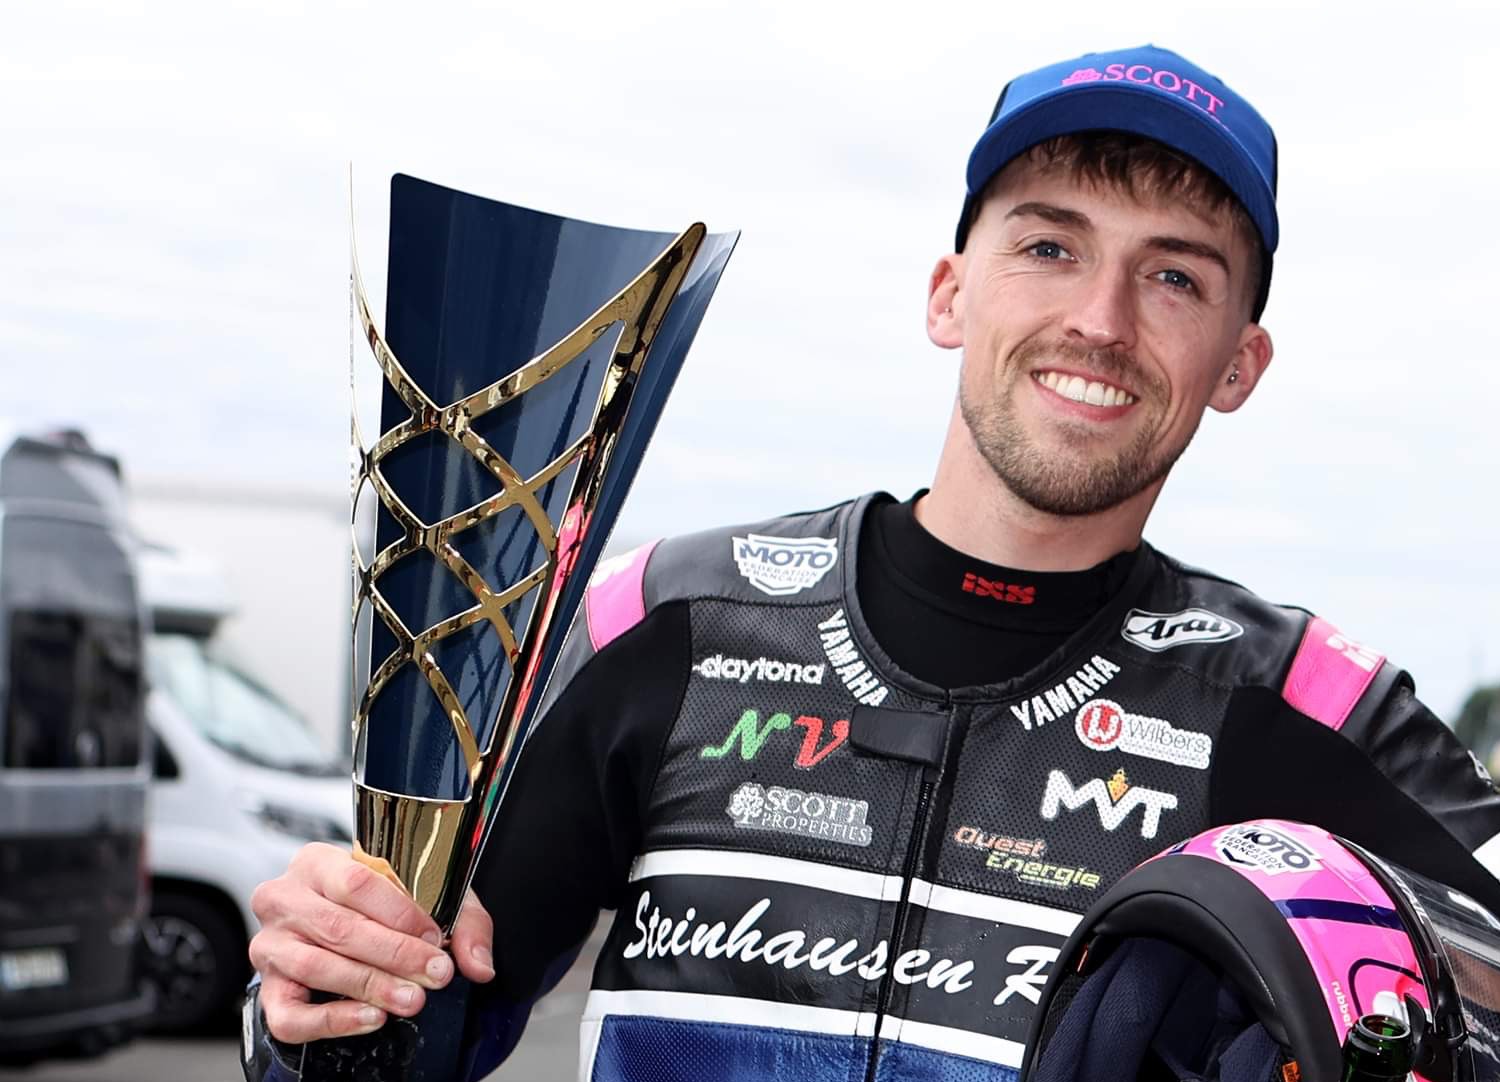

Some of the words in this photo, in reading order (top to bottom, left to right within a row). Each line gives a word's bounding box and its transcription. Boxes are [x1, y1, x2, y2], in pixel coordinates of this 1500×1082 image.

[1103, 63, 1224, 116] SCOTT
[739, 543, 833, 569] MOTO
[1125, 617, 1227, 641] Arai
[699, 653, 826, 685] daytona
[817, 608, 889, 707] YAMAHA
[1010, 654, 1121, 731] YAMAHA
[1128, 719, 1207, 754] Wilbers
[764, 789, 867, 825] SCOTT
[1041, 769, 1179, 839] MVT
[761, 811, 869, 843] PROPERTIES
[986, 853, 1101, 889] Energie
[623, 889, 975, 994] Steinhausen
